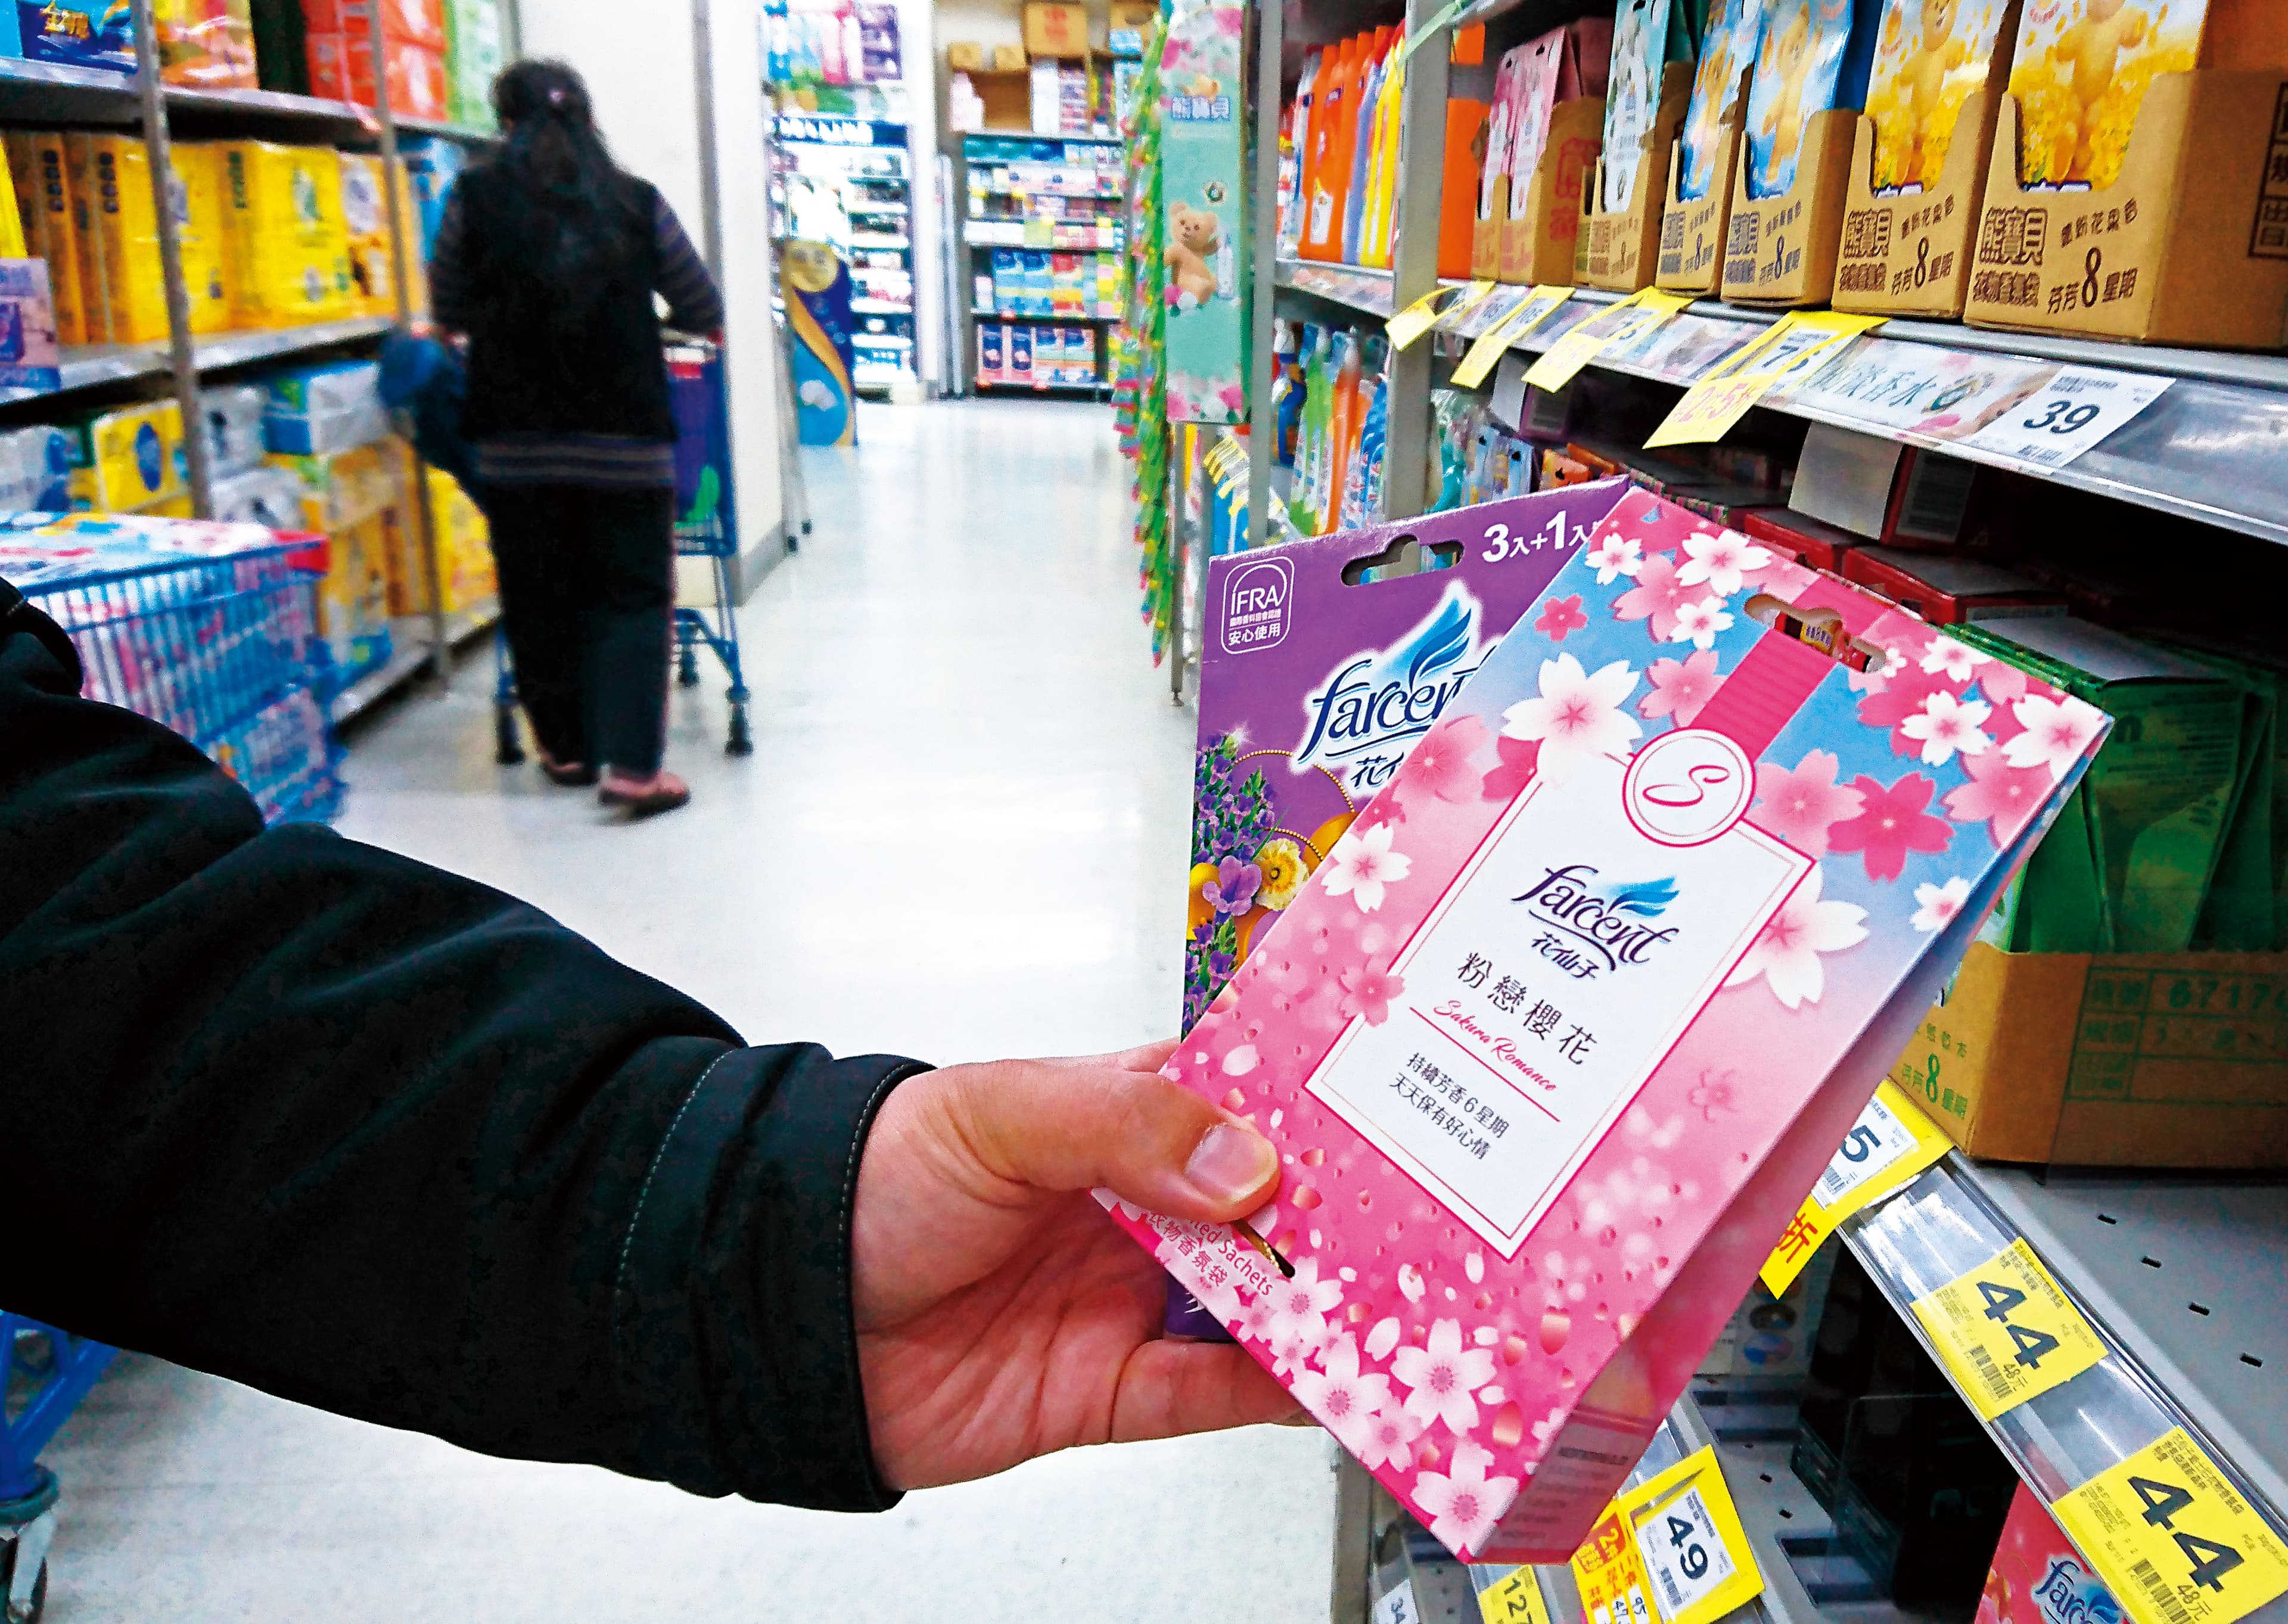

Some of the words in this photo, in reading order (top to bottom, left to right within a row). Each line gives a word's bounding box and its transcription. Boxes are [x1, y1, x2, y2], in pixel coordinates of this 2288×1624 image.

[1979, 206, 2048, 266] 熊寶貝
[2023, 400, 2100, 434] 39
[1231, 584, 1281, 615] IFRA
[1229, 623, 1280, 646] 安心使用
[1531, 931, 1599, 979] 花仙子
[1457, 952, 1597, 1065] 粉戀櫻花
[1433, 1000, 1490, 1044] Sakura
[1490, 1037, 1556, 1091] Romance
[1389, 1072, 1490, 1160] 天天保有好心情
[1218, 1239, 1273, 1295] Sachets
[1976, 1281, 2059, 1370] 44
[1668, 1514, 1708, 1580] 49
[2128, 1476, 2244, 1592] 44
[2034, 1560, 2093, 1624] farc
[2177, 1583, 2214, 1623] 48元
